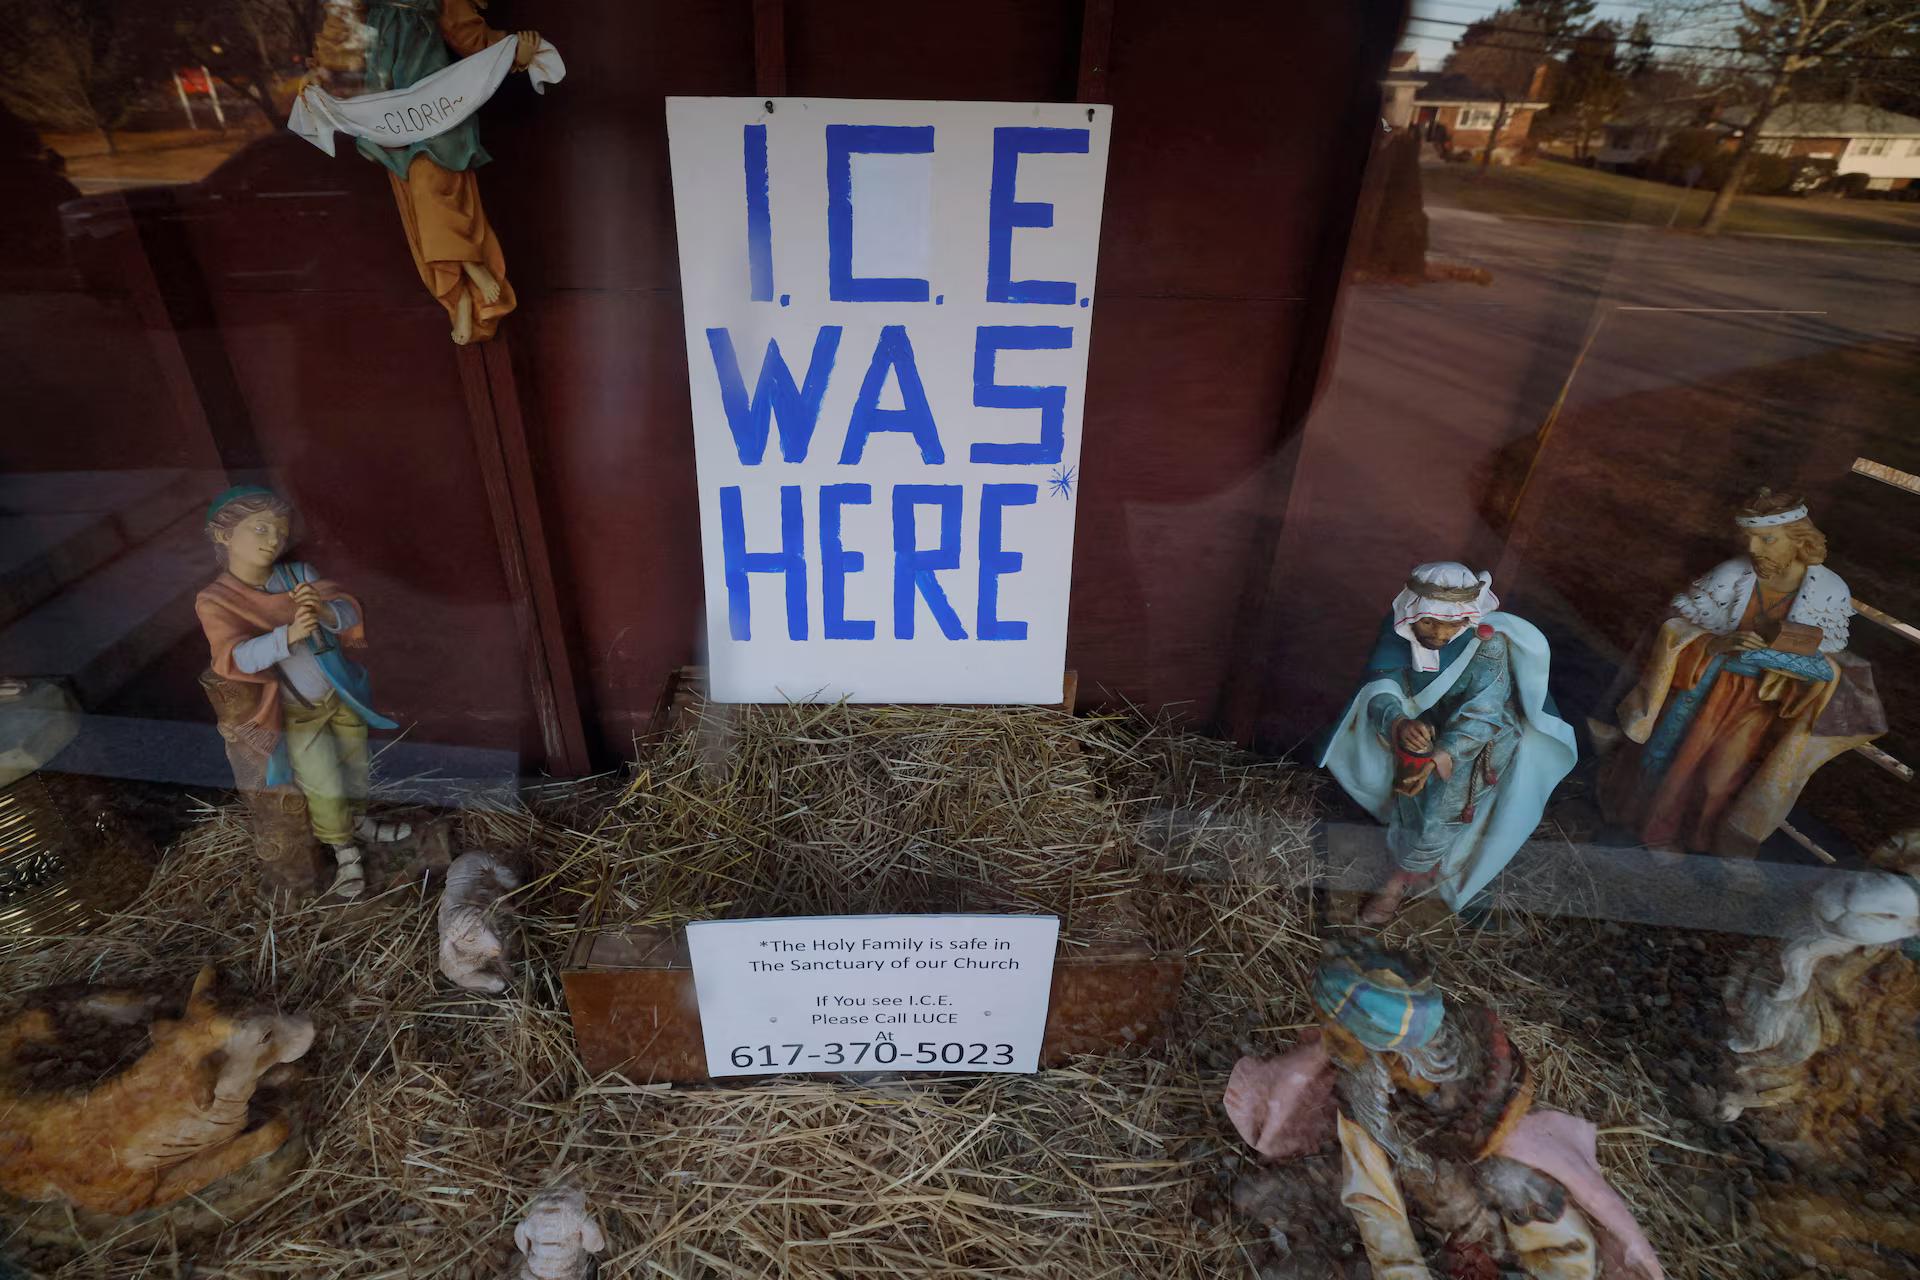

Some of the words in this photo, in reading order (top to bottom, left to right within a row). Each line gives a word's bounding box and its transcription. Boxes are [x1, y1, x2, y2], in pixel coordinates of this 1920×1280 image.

[743, 124, 1091, 308] I.C.E.
[705, 325, 1074, 466] WAS
[813, 938, 855, 953] Holy
[862, 937, 924, 952] Family
[930, 937, 943, 950] is
[949, 937, 988, 950] safe
[994, 938, 1011, 950] in
[748, 959, 784, 972] The
[790, 959, 885, 972] Sanctuary
[890, 956, 911, 969] of
[915, 959, 948, 969] our
[953, 956, 1020, 970] Church
[816, 995, 829, 1007] If
[834, 995, 866, 1007] You
[872, 997, 903, 1006] see
[909, 995, 953, 1006] I.C.E.
[812, 1014, 869, 1025] Please
[875, 1013, 907, 1024] Call
[913, 1013, 959, 1024] LUCE
[875, 1030, 895, 1041] At
[730, 1042, 1014, 1068] 617-370-5023
